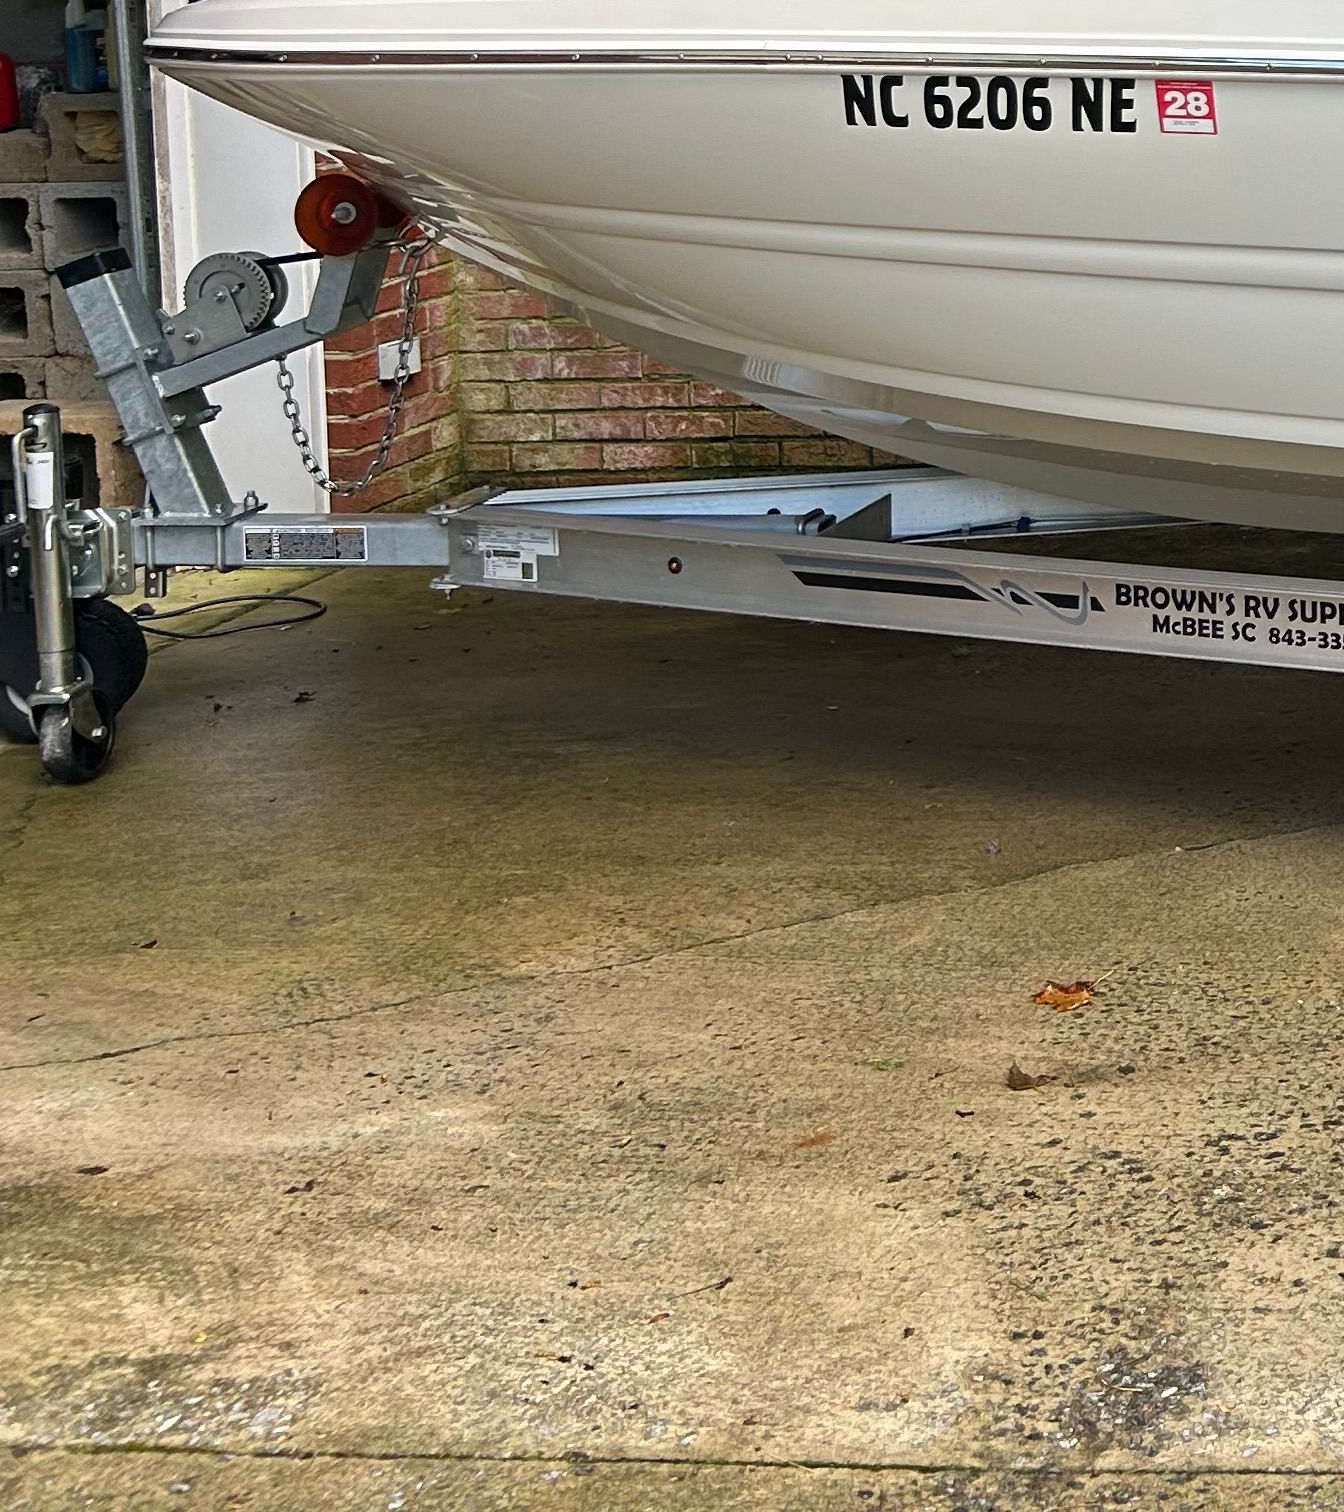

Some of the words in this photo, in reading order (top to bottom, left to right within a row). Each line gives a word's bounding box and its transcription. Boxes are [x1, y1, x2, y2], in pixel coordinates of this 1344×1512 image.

[841, 75, 909, 127] NC
[924, 76, 1051, 131] 6206
[1069, 78, 1137, 133] NE
[1164, 90, 1210, 117] 28
[1115, 583, 1236, 617] BROWN'S
[1244, 595, 1280, 620] RV
[1152, 614, 1224, 639] McBEE
[1231, 622, 1256, 642] SC
